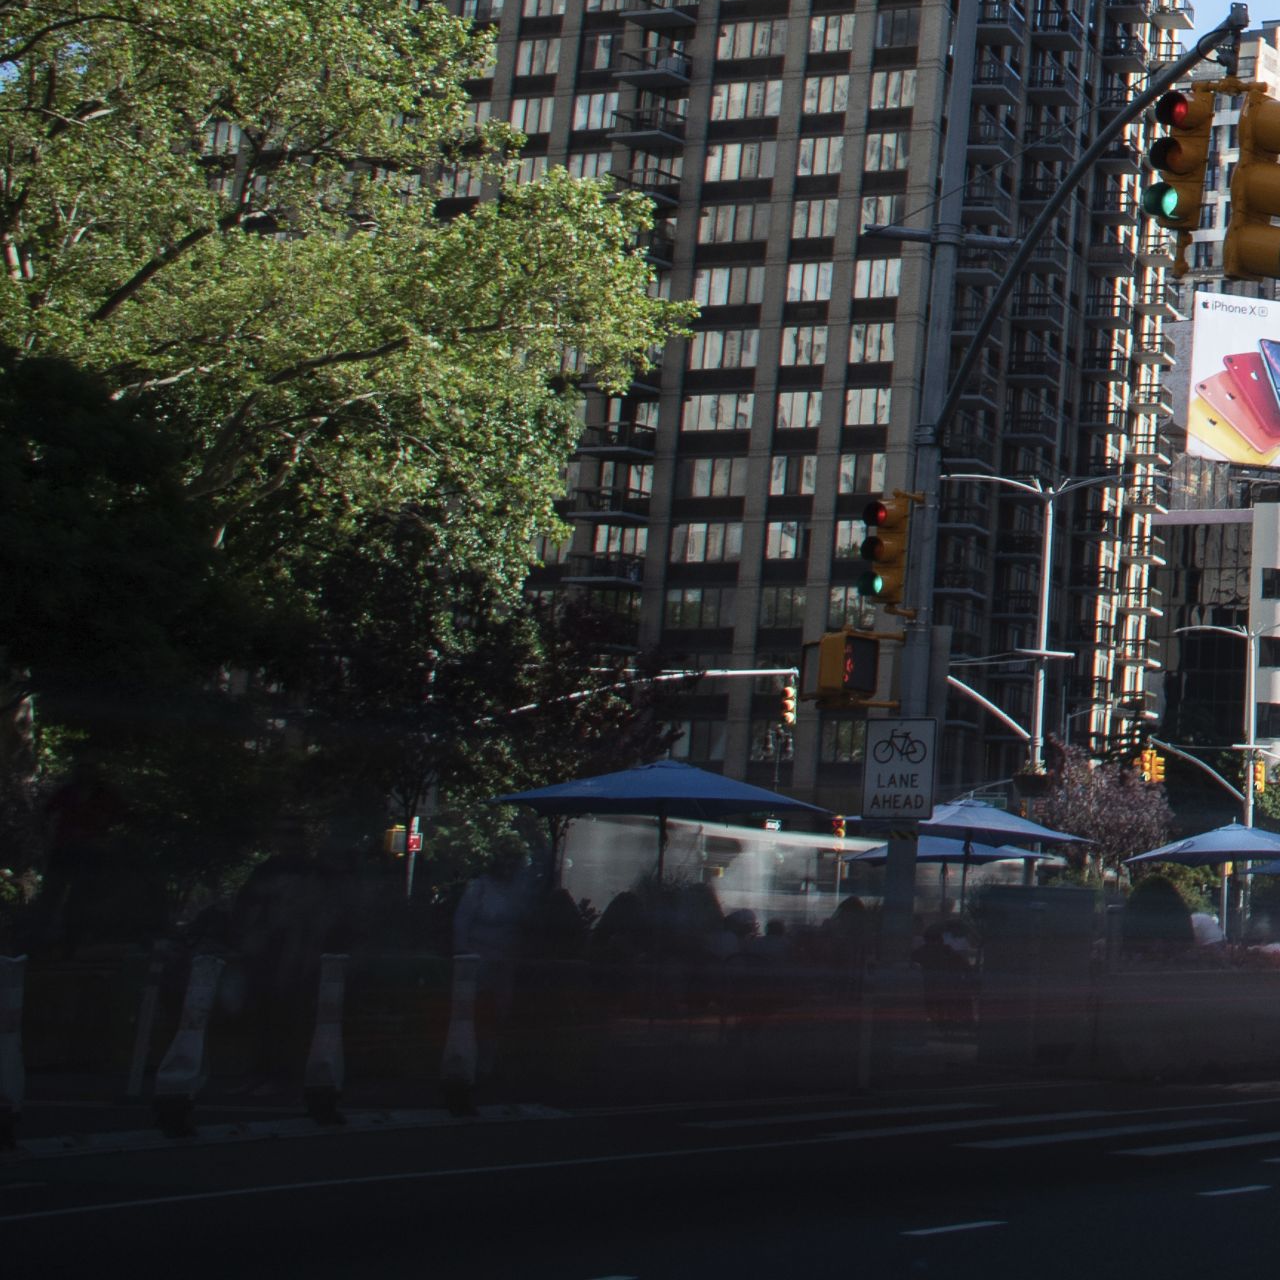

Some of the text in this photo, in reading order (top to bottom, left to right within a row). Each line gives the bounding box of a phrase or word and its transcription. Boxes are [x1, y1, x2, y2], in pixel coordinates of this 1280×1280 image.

[1211, 301, 1247, 314] iPhone
[1249, 306, 1257, 315] X
[877, 773, 919, 789] LANE
[870, 794, 924, 810] AHEAD
